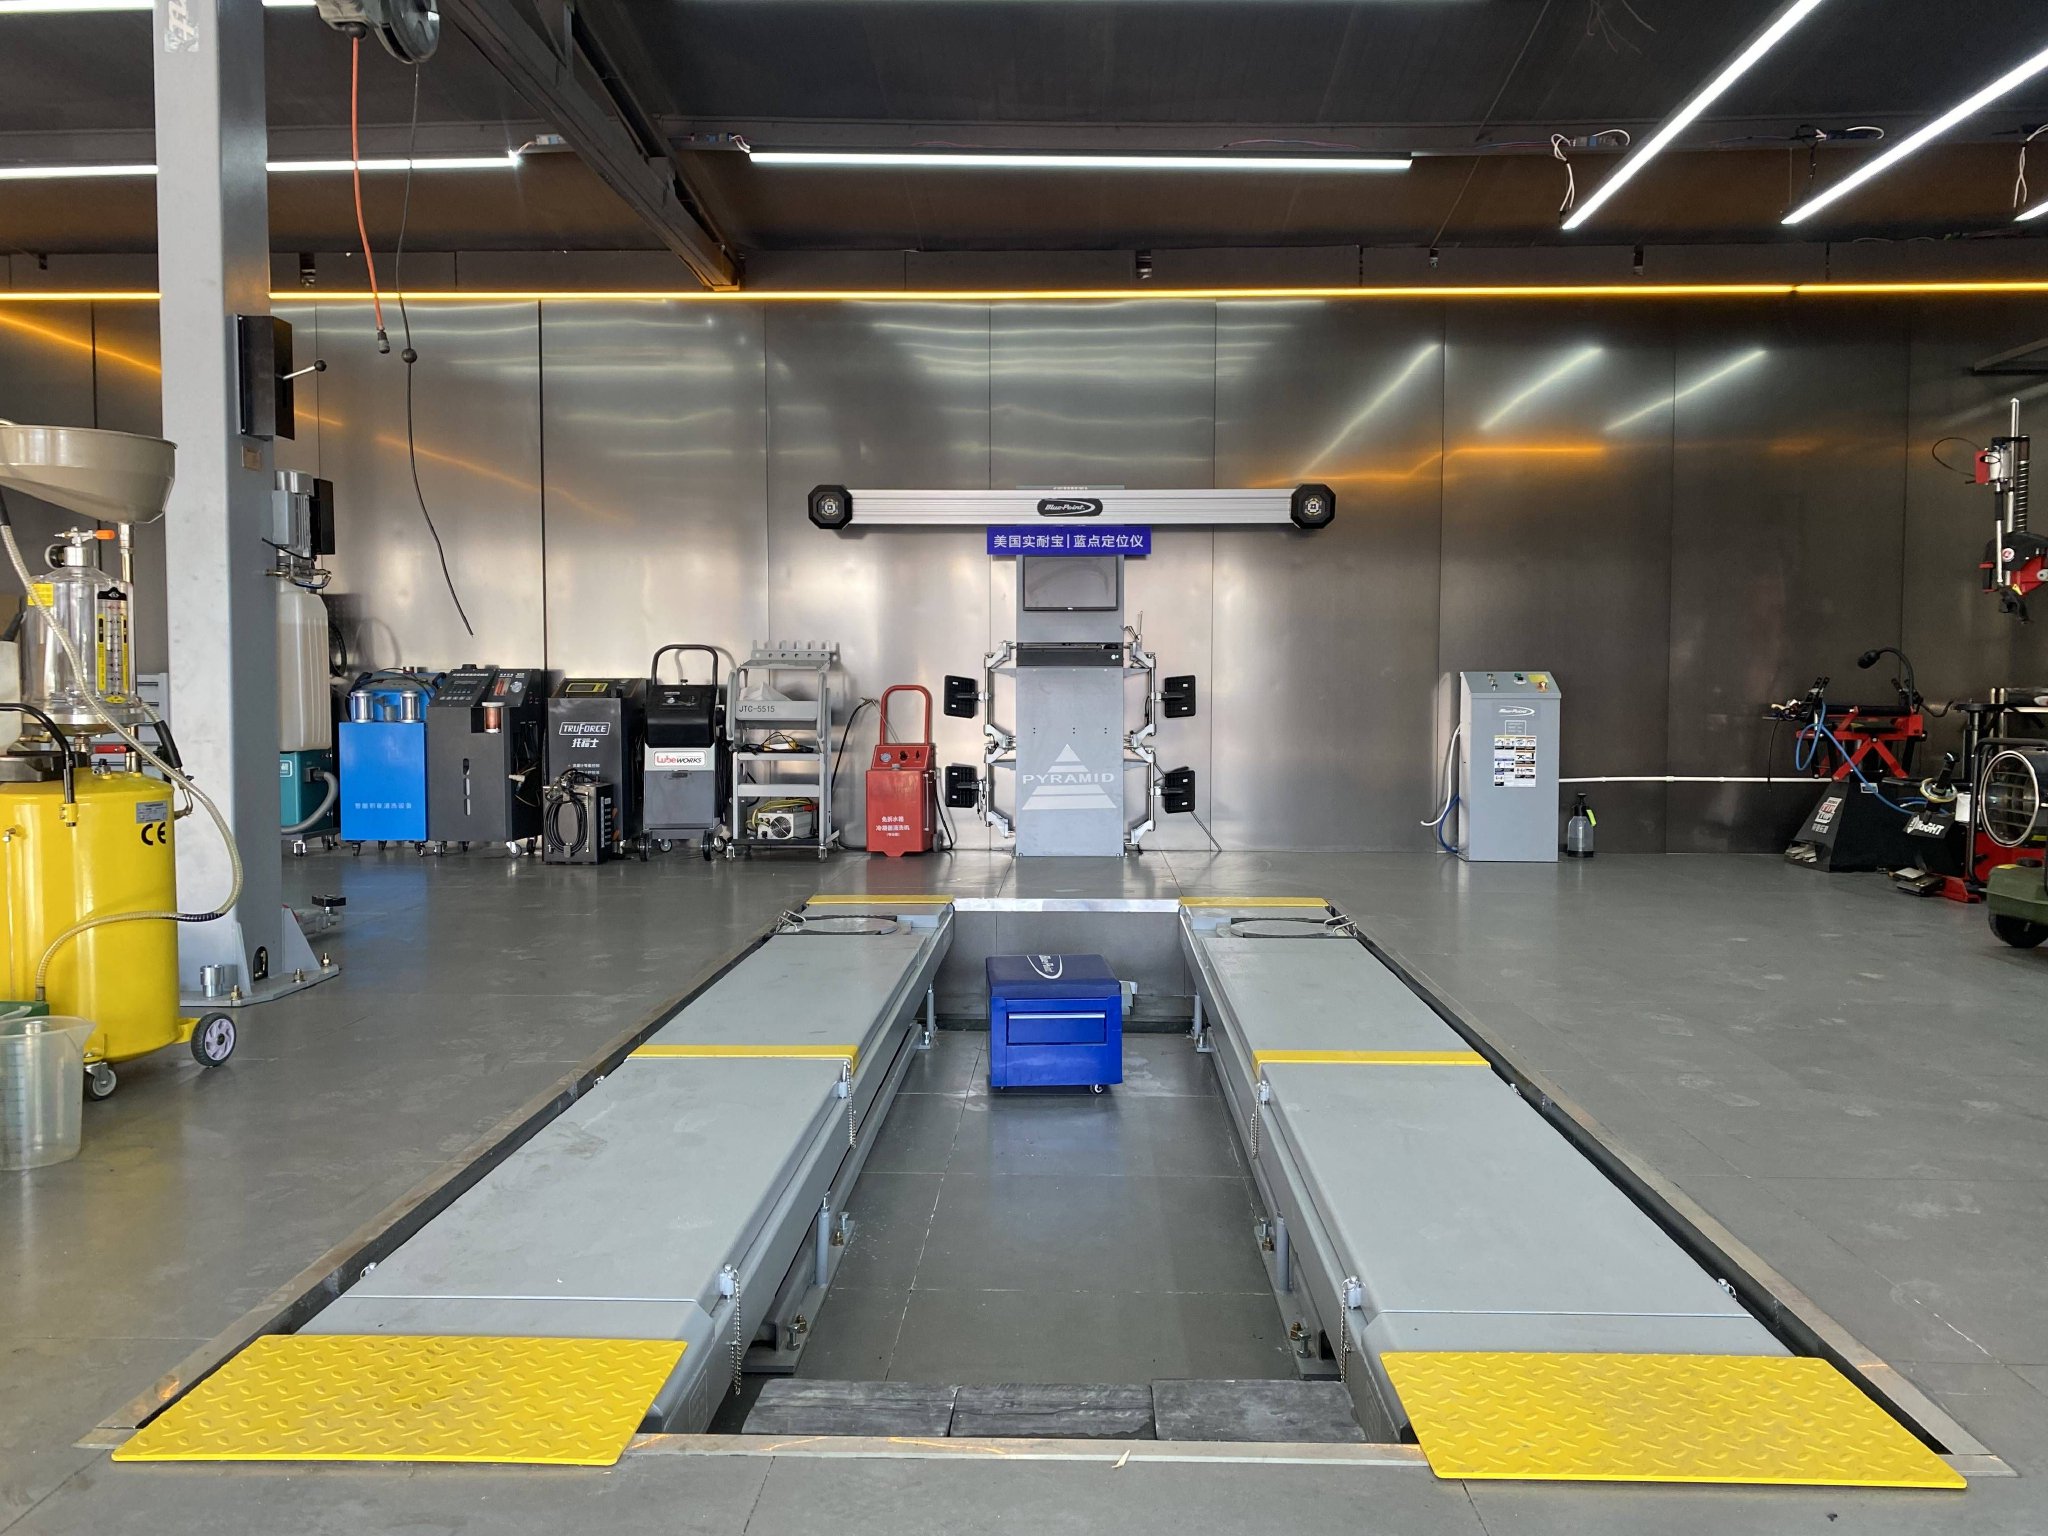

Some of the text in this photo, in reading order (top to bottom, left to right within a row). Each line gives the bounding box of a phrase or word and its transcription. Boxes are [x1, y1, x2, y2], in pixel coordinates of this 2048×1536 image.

[1045, 503, 1086, 511] Blue-Point
[563, 723, 608, 735] TRUFORCE
[1022, 772, 1115, 785] PYRAMID
